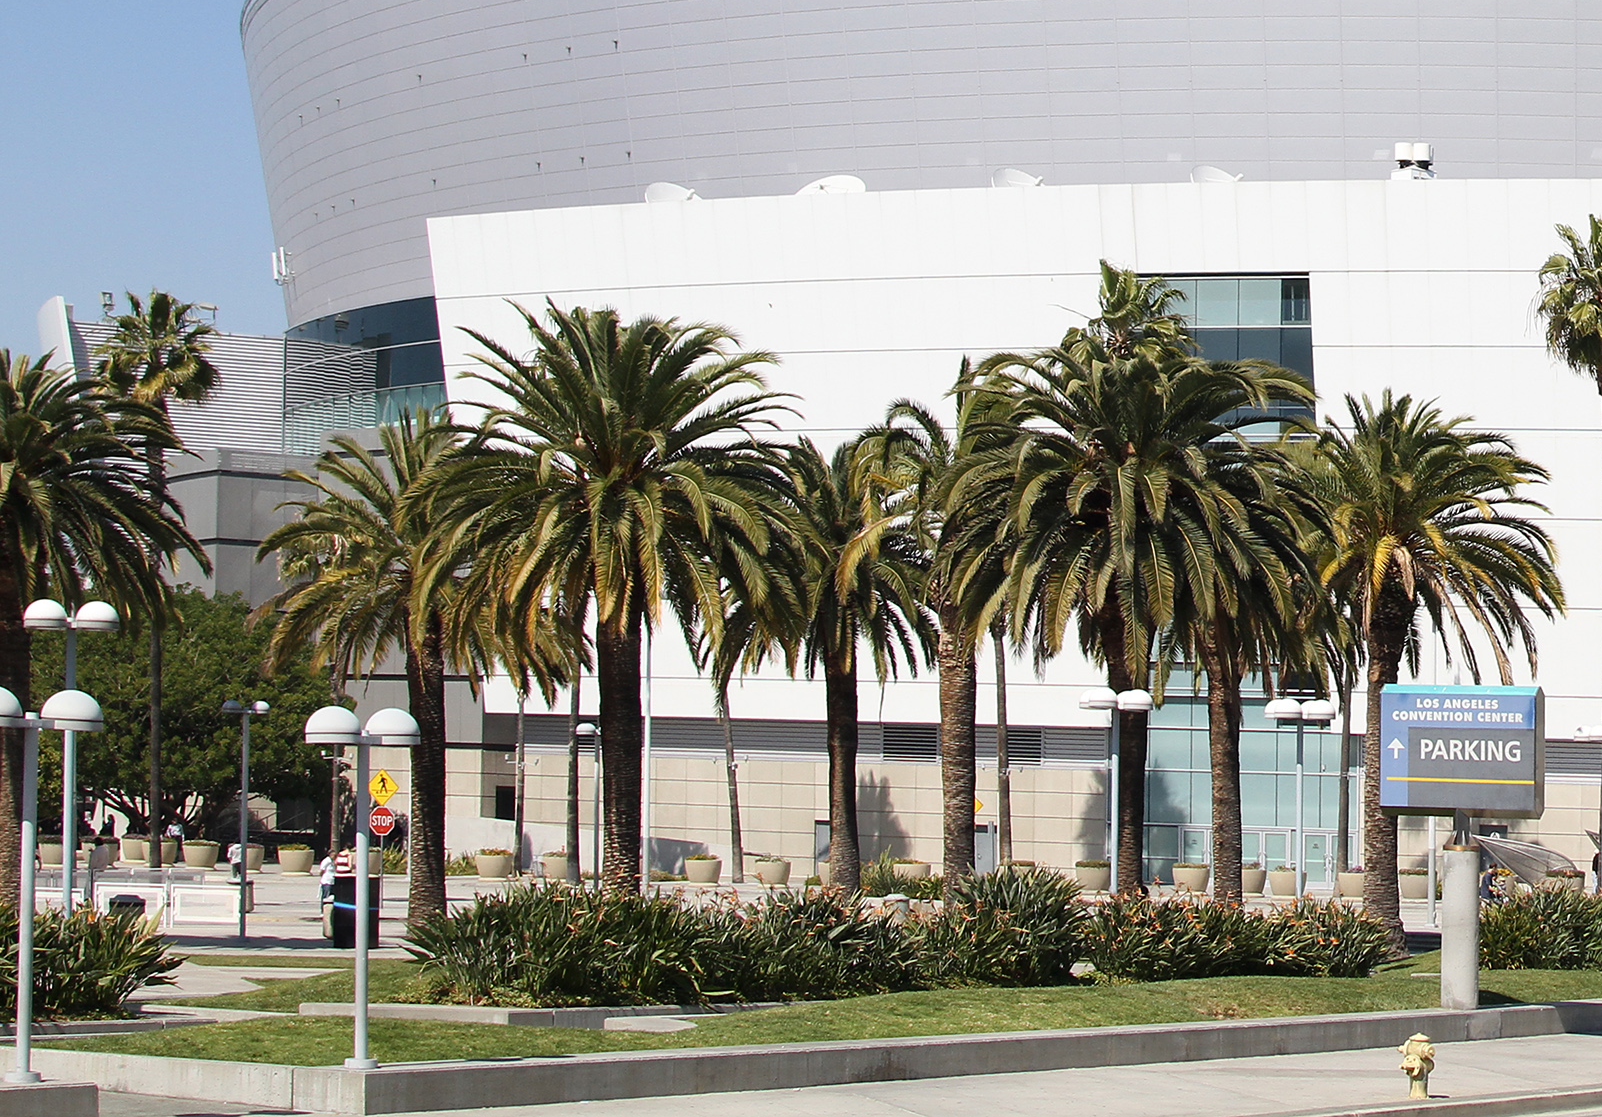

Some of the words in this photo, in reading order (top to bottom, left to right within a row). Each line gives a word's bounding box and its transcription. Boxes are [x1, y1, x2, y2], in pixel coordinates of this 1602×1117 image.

[1416, 698, 1440, 709] LOS
[1443, 699, 1499, 710] ANGELES
[1392, 710, 1473, 722] CONVENTION
[1477, 712, 1524, 723] CENTER
[1419, 738, 1522, 762] PARKING
[371, 815, 393, 826] STOP
